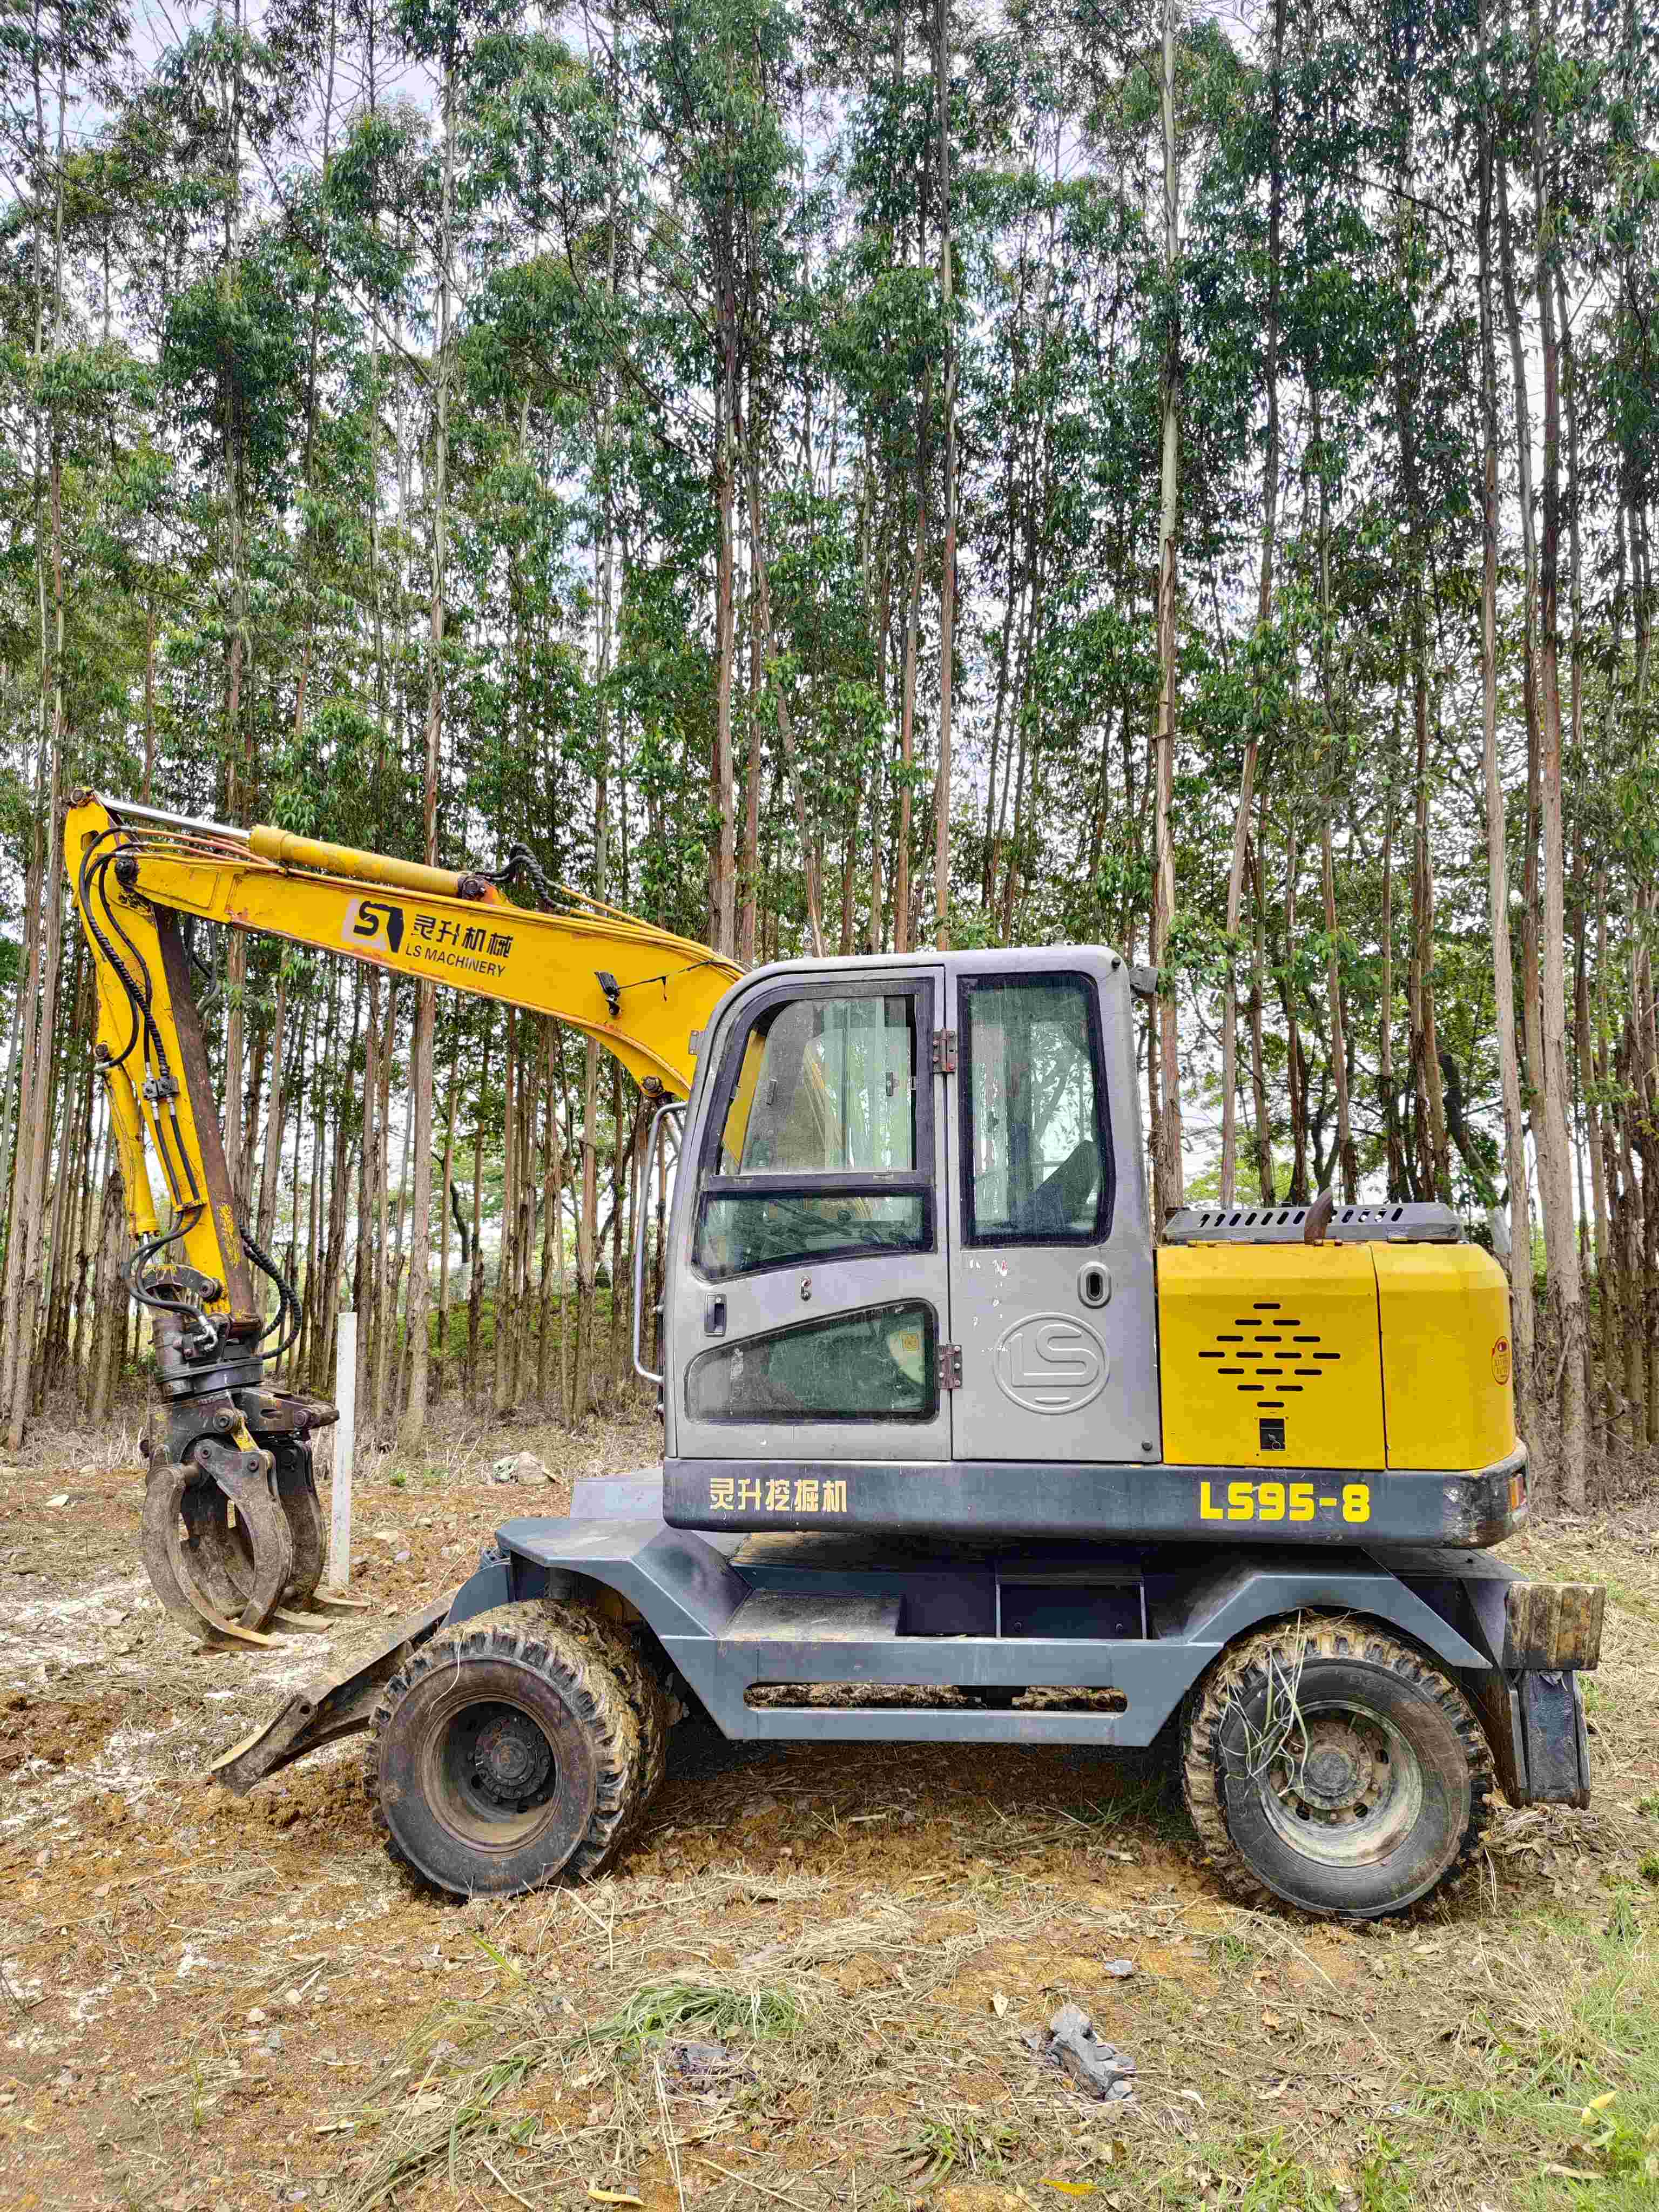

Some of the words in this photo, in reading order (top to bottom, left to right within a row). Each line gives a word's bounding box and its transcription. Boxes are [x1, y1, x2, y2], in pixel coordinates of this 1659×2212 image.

[413, 914, 514, 958] 灵升机械
[406, 943, 422, 957] LS
[424, 948, 505, 977] MACHINERY
[709, 1478, 847, 1512] 灵升挖掘机
[1200, 1481, 1370, 1523] LS95-8
